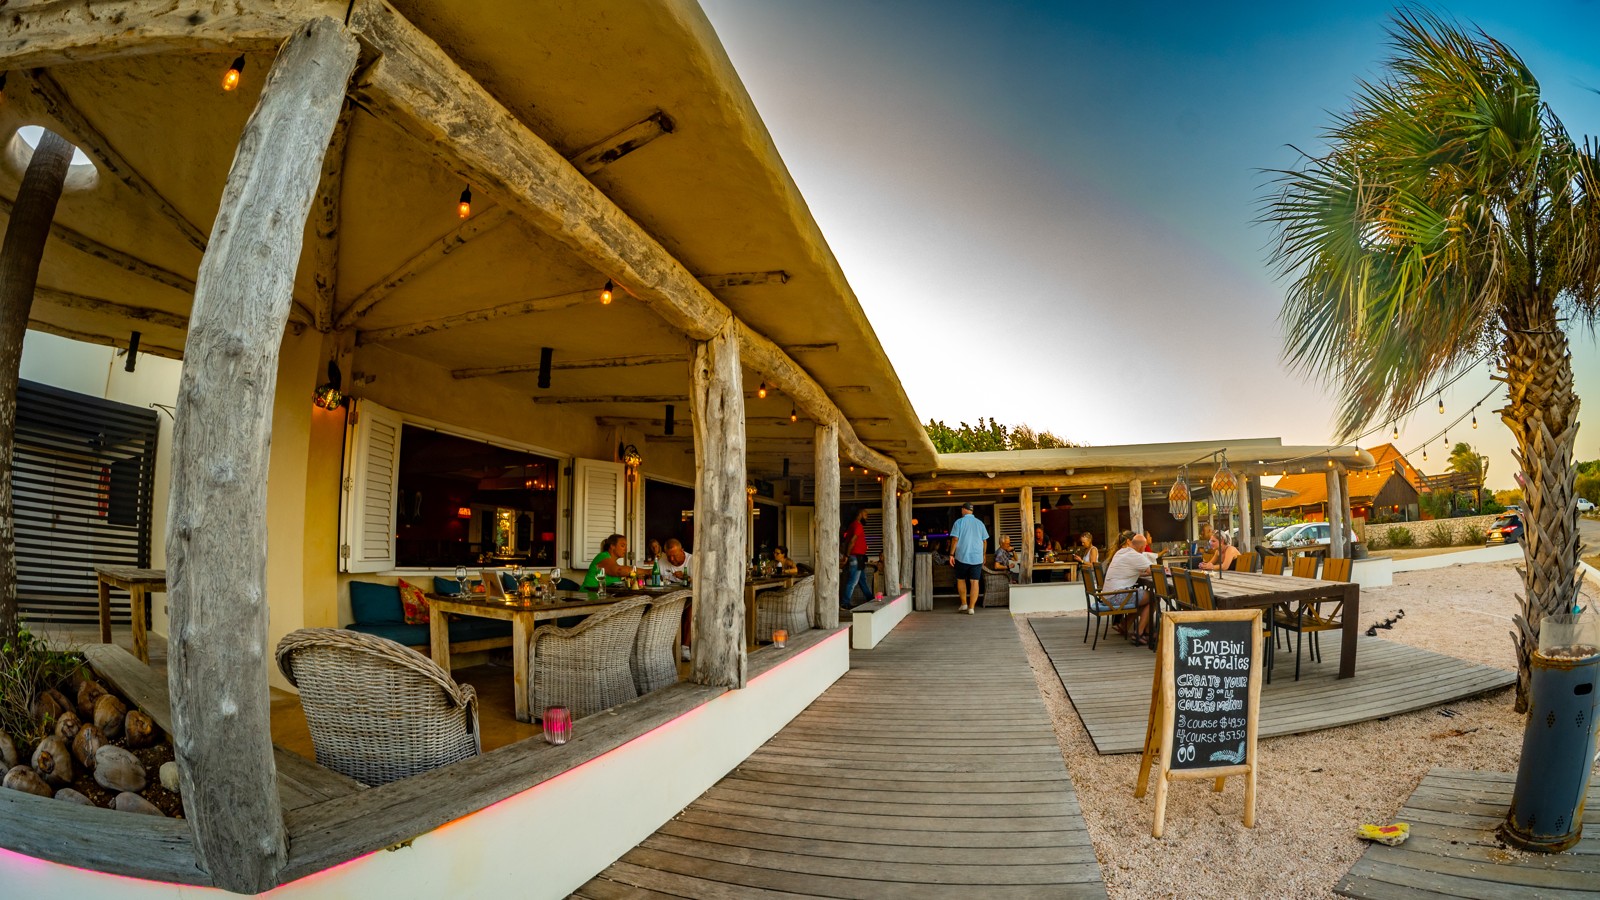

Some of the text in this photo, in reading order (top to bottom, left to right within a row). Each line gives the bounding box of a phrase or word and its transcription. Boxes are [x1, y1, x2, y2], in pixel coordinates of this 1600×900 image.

[1188, 656, 1202, 666] NA
[1224, 676, 1247, 689] YOUR
[1178, 687, 1203, 698] OWN
[1206, 688, 1214, 700] 3
[1224, 689, 1234, 701] 4
[1178, 714, 1186, 727] 3
[1176, 729, 1186, 743] 4
